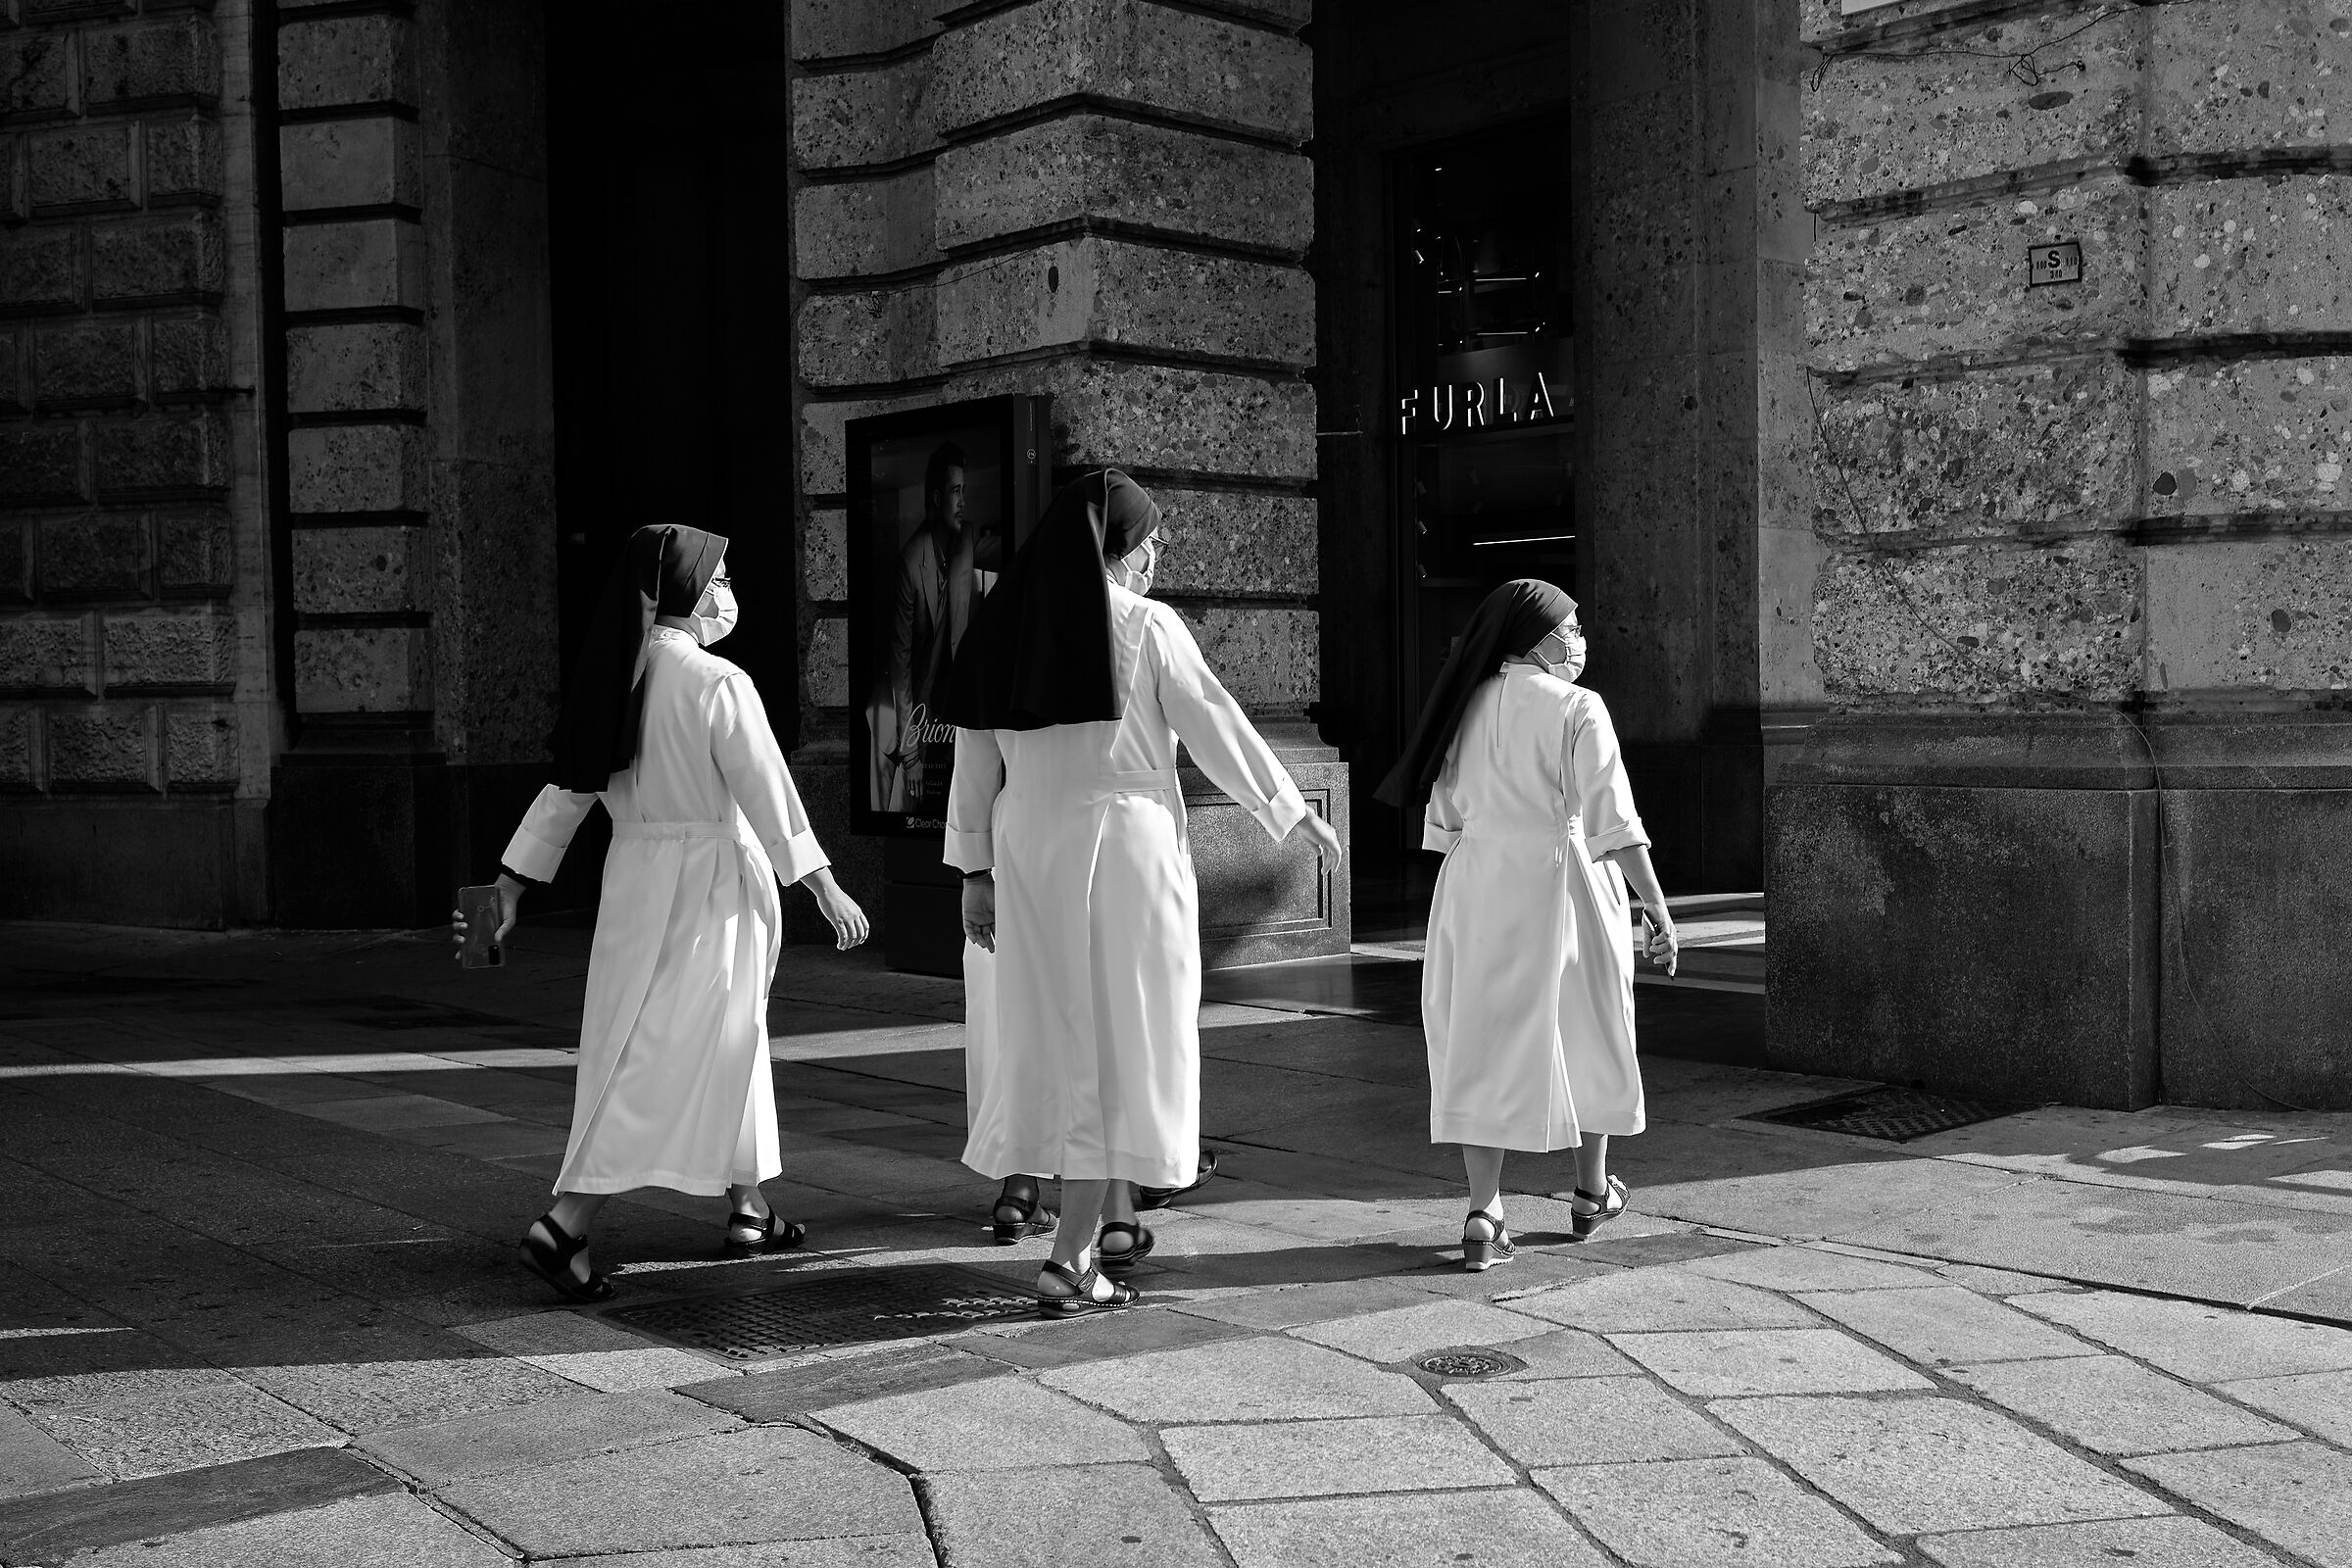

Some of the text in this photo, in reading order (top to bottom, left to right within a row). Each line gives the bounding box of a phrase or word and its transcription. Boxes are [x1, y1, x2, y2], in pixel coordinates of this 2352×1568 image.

[2047, 250, 2061, 268] S
[1399, 370, 1554, 435] FURLA
[900, 703, 956, 752] Brion
